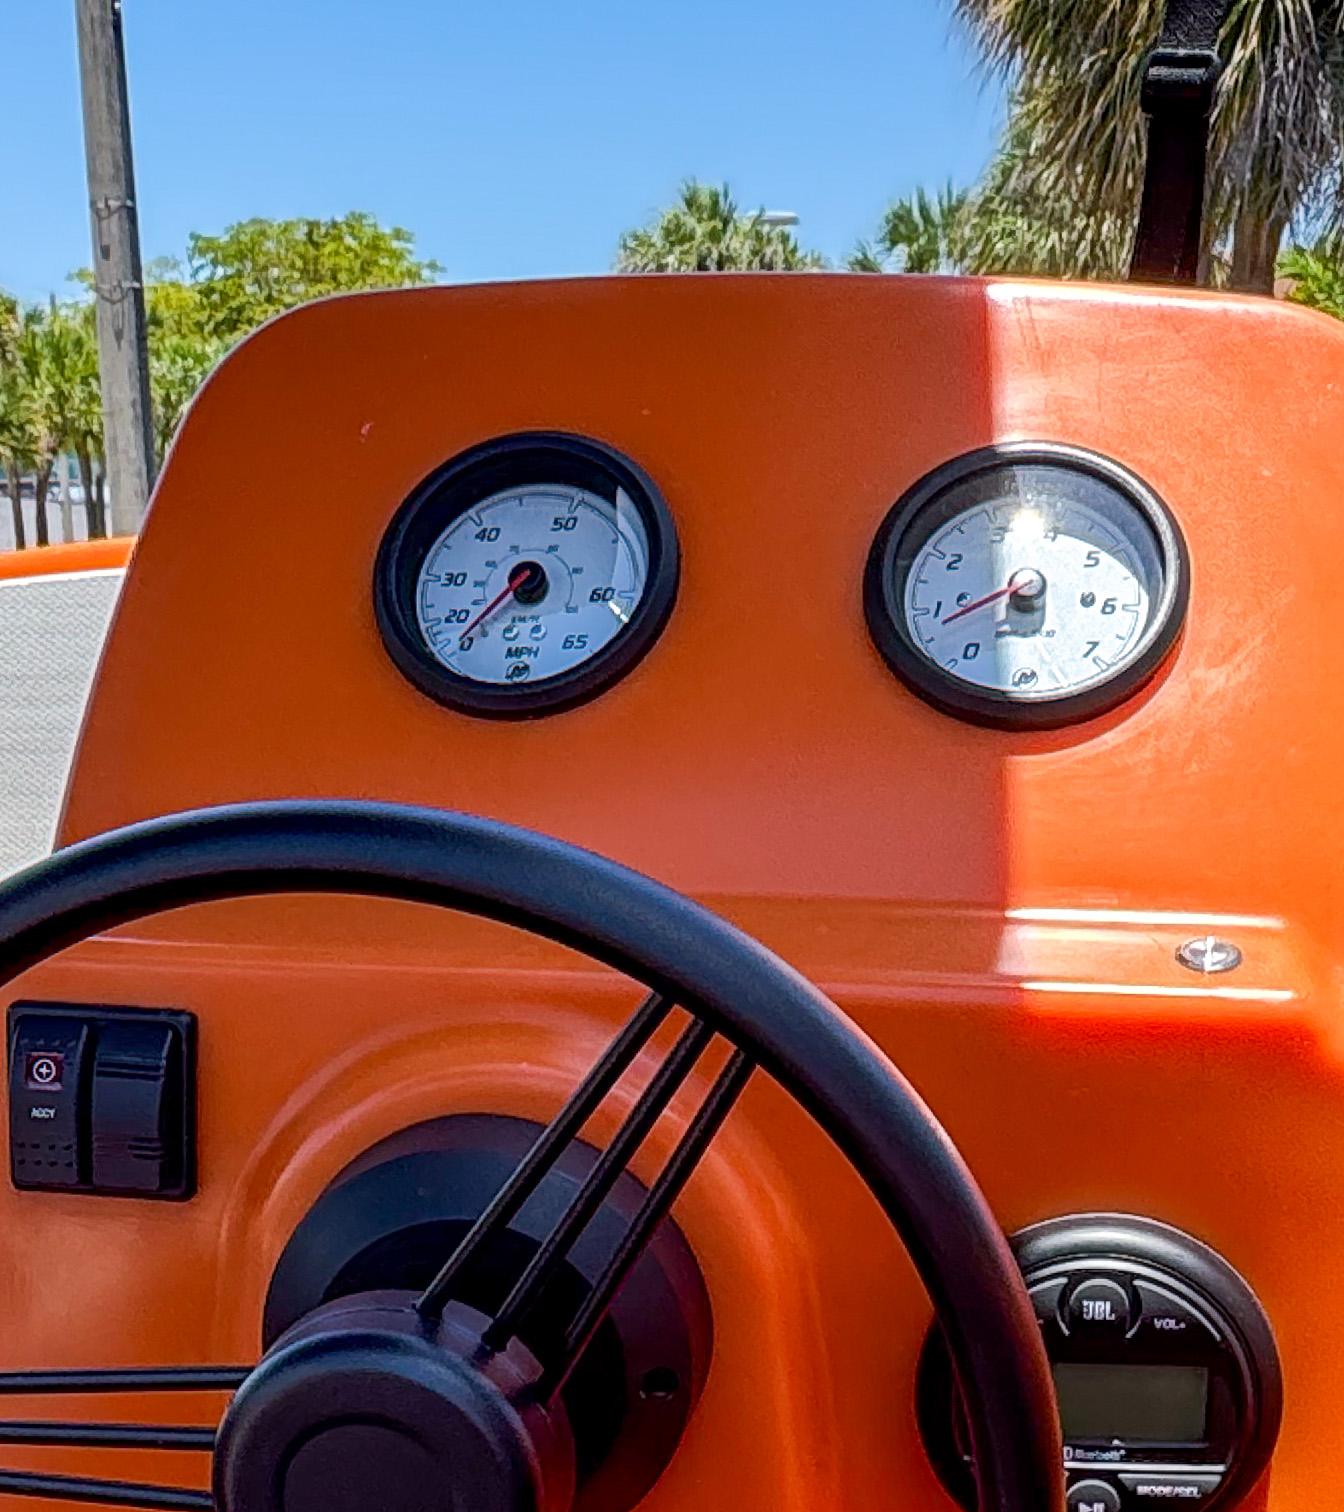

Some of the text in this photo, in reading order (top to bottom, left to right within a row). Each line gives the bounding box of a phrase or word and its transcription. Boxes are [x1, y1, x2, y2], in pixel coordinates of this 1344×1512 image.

[551, 516, 578, 532] 50
[475, 527, 501, 543] 40
[990, 526, 1007, 544] 3
[946, 553, 964, 571] 2
[1083, 551, 1101, 568] 5
[440, 572, 468, 588] 30
[589, 588, 616, 603] 60
[932, 600, 943, 619] 1
[1100, 597, 1117, 615] 6
[444, 609, 470, 624] 20
[458, 636, 474, 651] 0
[561, 634, 589, 650] 65
[1082, 640, 1100, 659] 7
[504, 646, 540, 660] MPH
[962, 641, 981, 660] 0
[30, 1107, 56, 1120] ACCY
[1081, 1299, 1116, 1321] JBL
